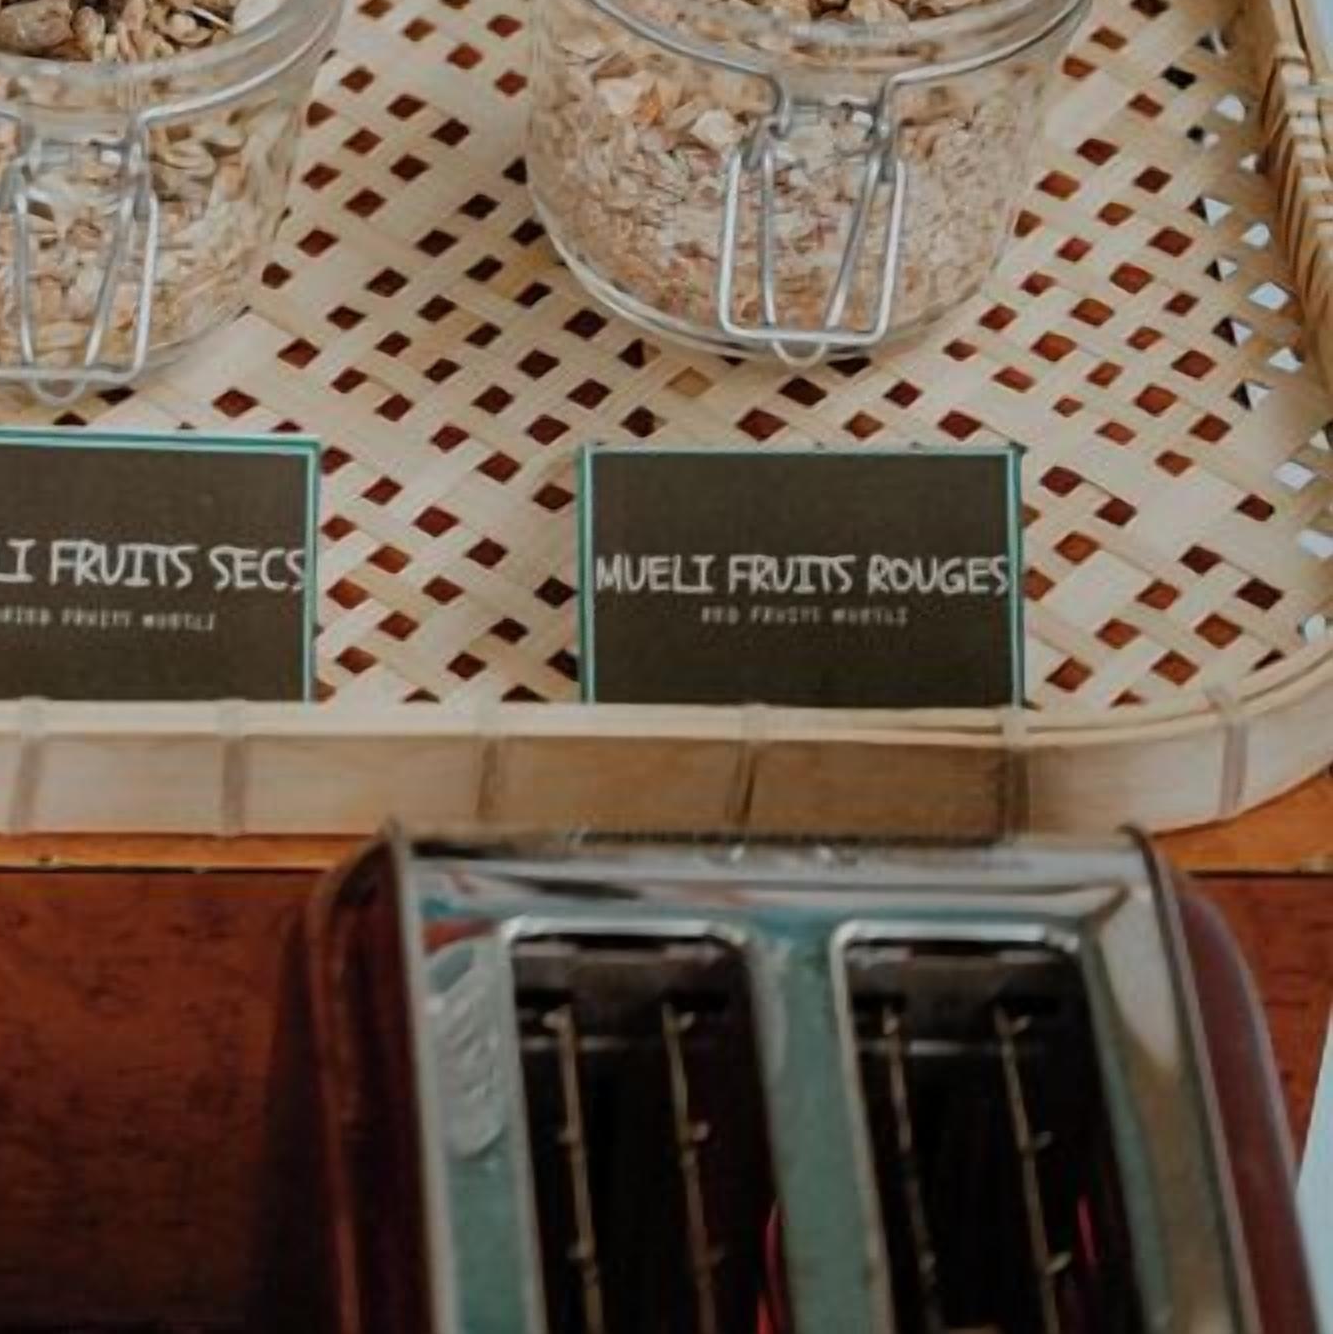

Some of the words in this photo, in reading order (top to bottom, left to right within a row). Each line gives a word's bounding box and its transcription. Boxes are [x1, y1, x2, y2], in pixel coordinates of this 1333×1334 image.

[49, 539, 200, 588] FRUITS
[209, 545, 306, 592] SECS
[596, 554, 714, 594] MUELI
[729, 554, 856, 594] FRUITS
[867, 554, 1009, 595] ROUGES
